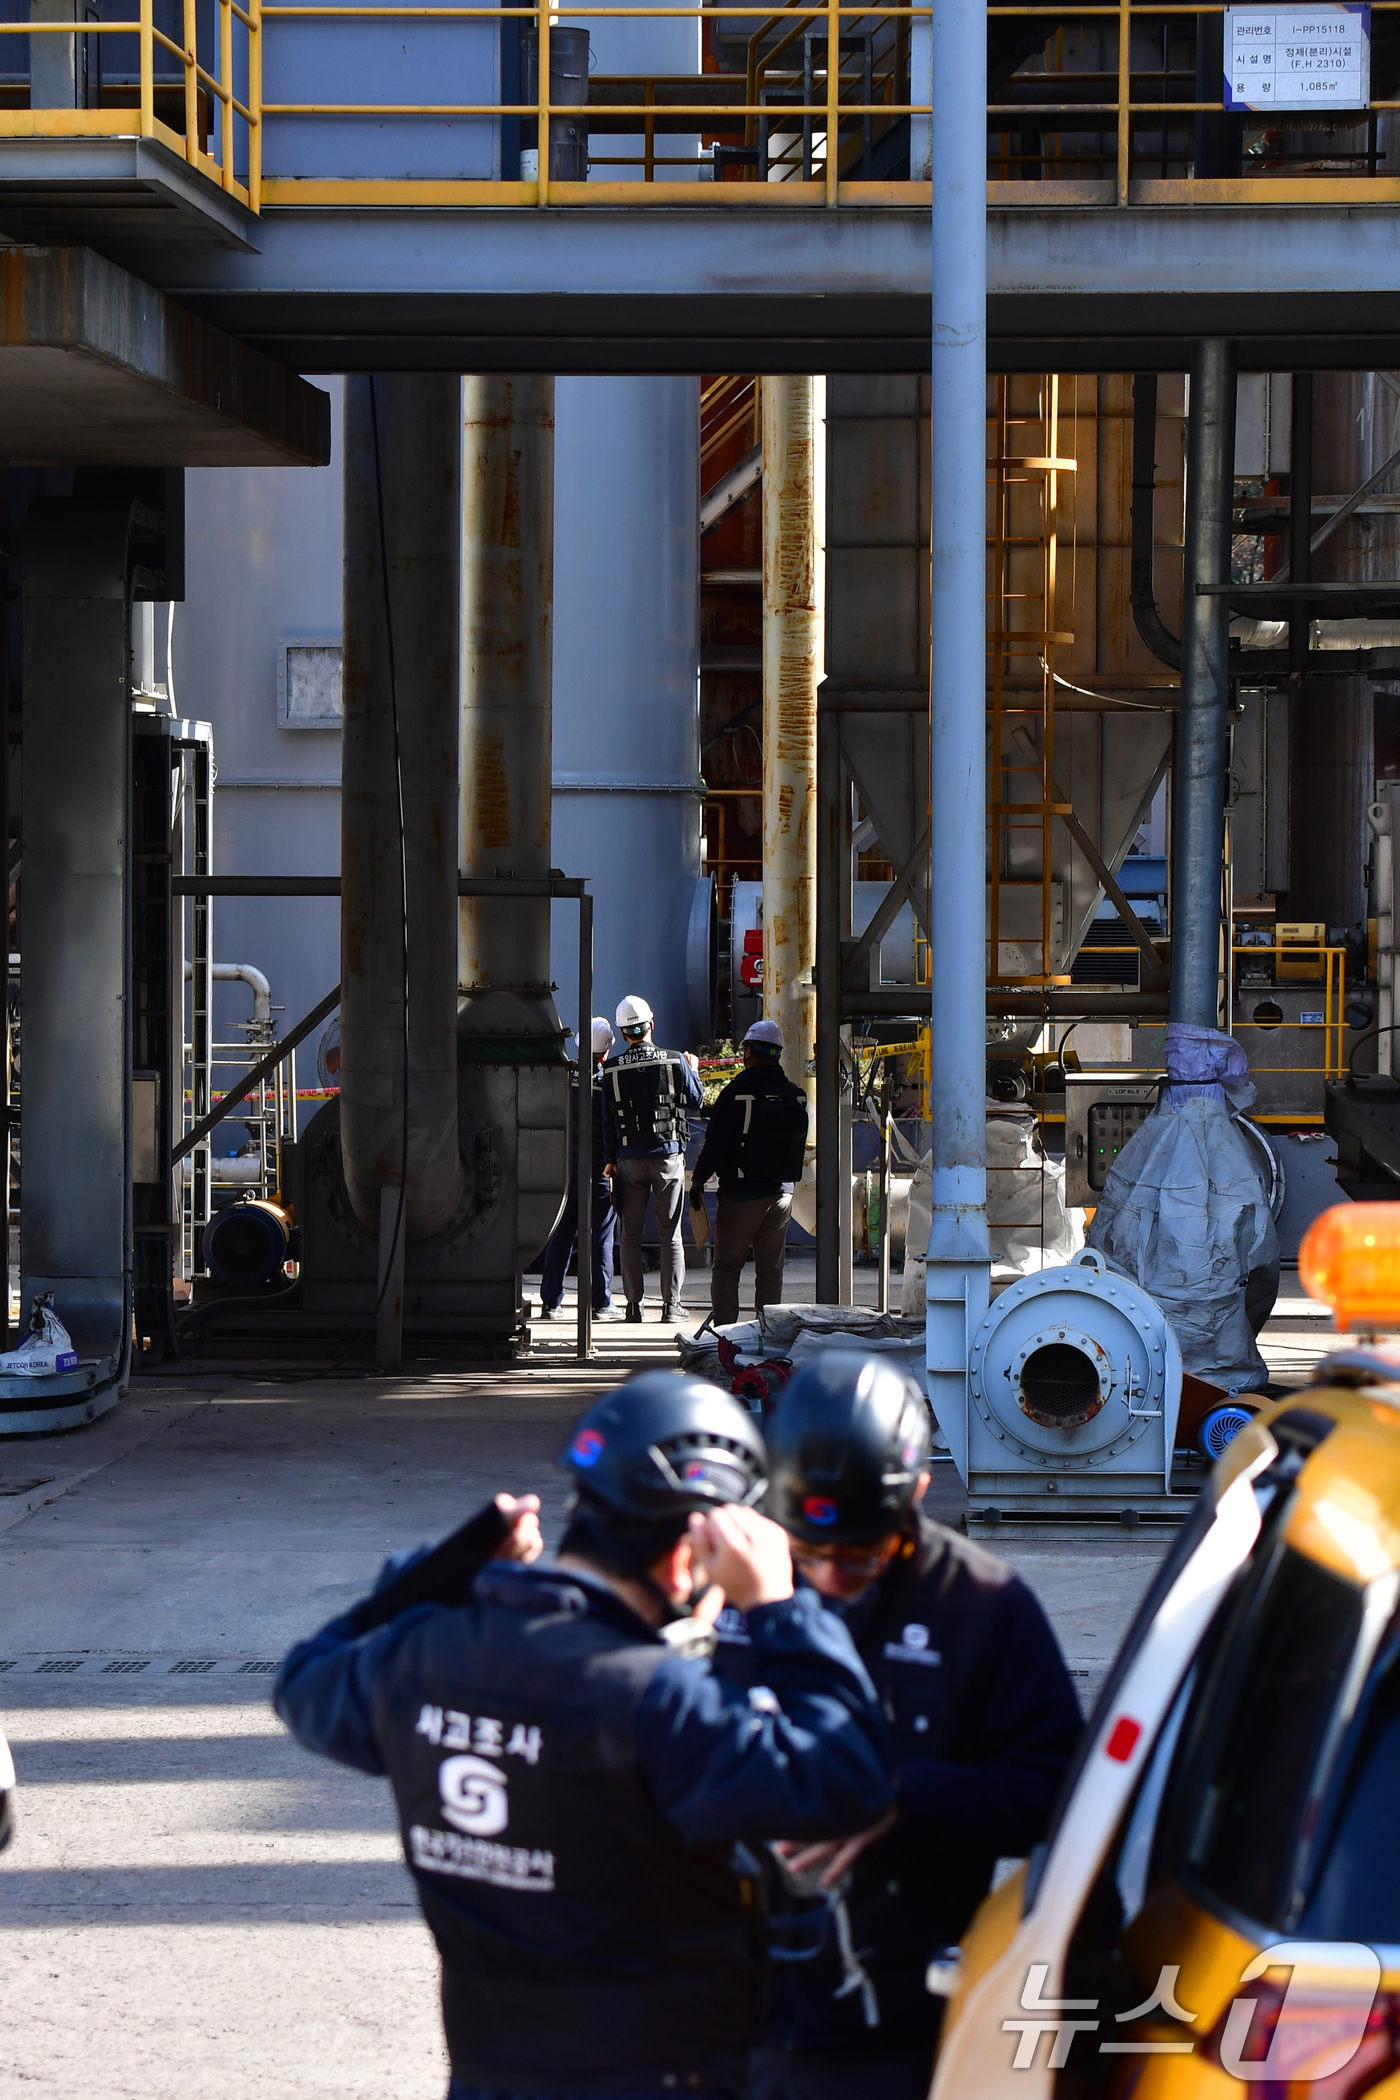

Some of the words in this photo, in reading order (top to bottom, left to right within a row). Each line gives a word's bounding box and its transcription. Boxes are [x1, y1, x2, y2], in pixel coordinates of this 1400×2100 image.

[1236, 26, 1272, 36] 관리번호
[1292, 25, 1345, 34] I-PP15118
[1285, 47, 1352, 57] 정제(분리)시설
[1290, 60, 1313, 70] (F.H
[1317, 60, 1346, 69] 2310)
[618, 1050, 667, 1065] 중앙사고조사단
[415, 1703, 543, 1766] 사고조사
